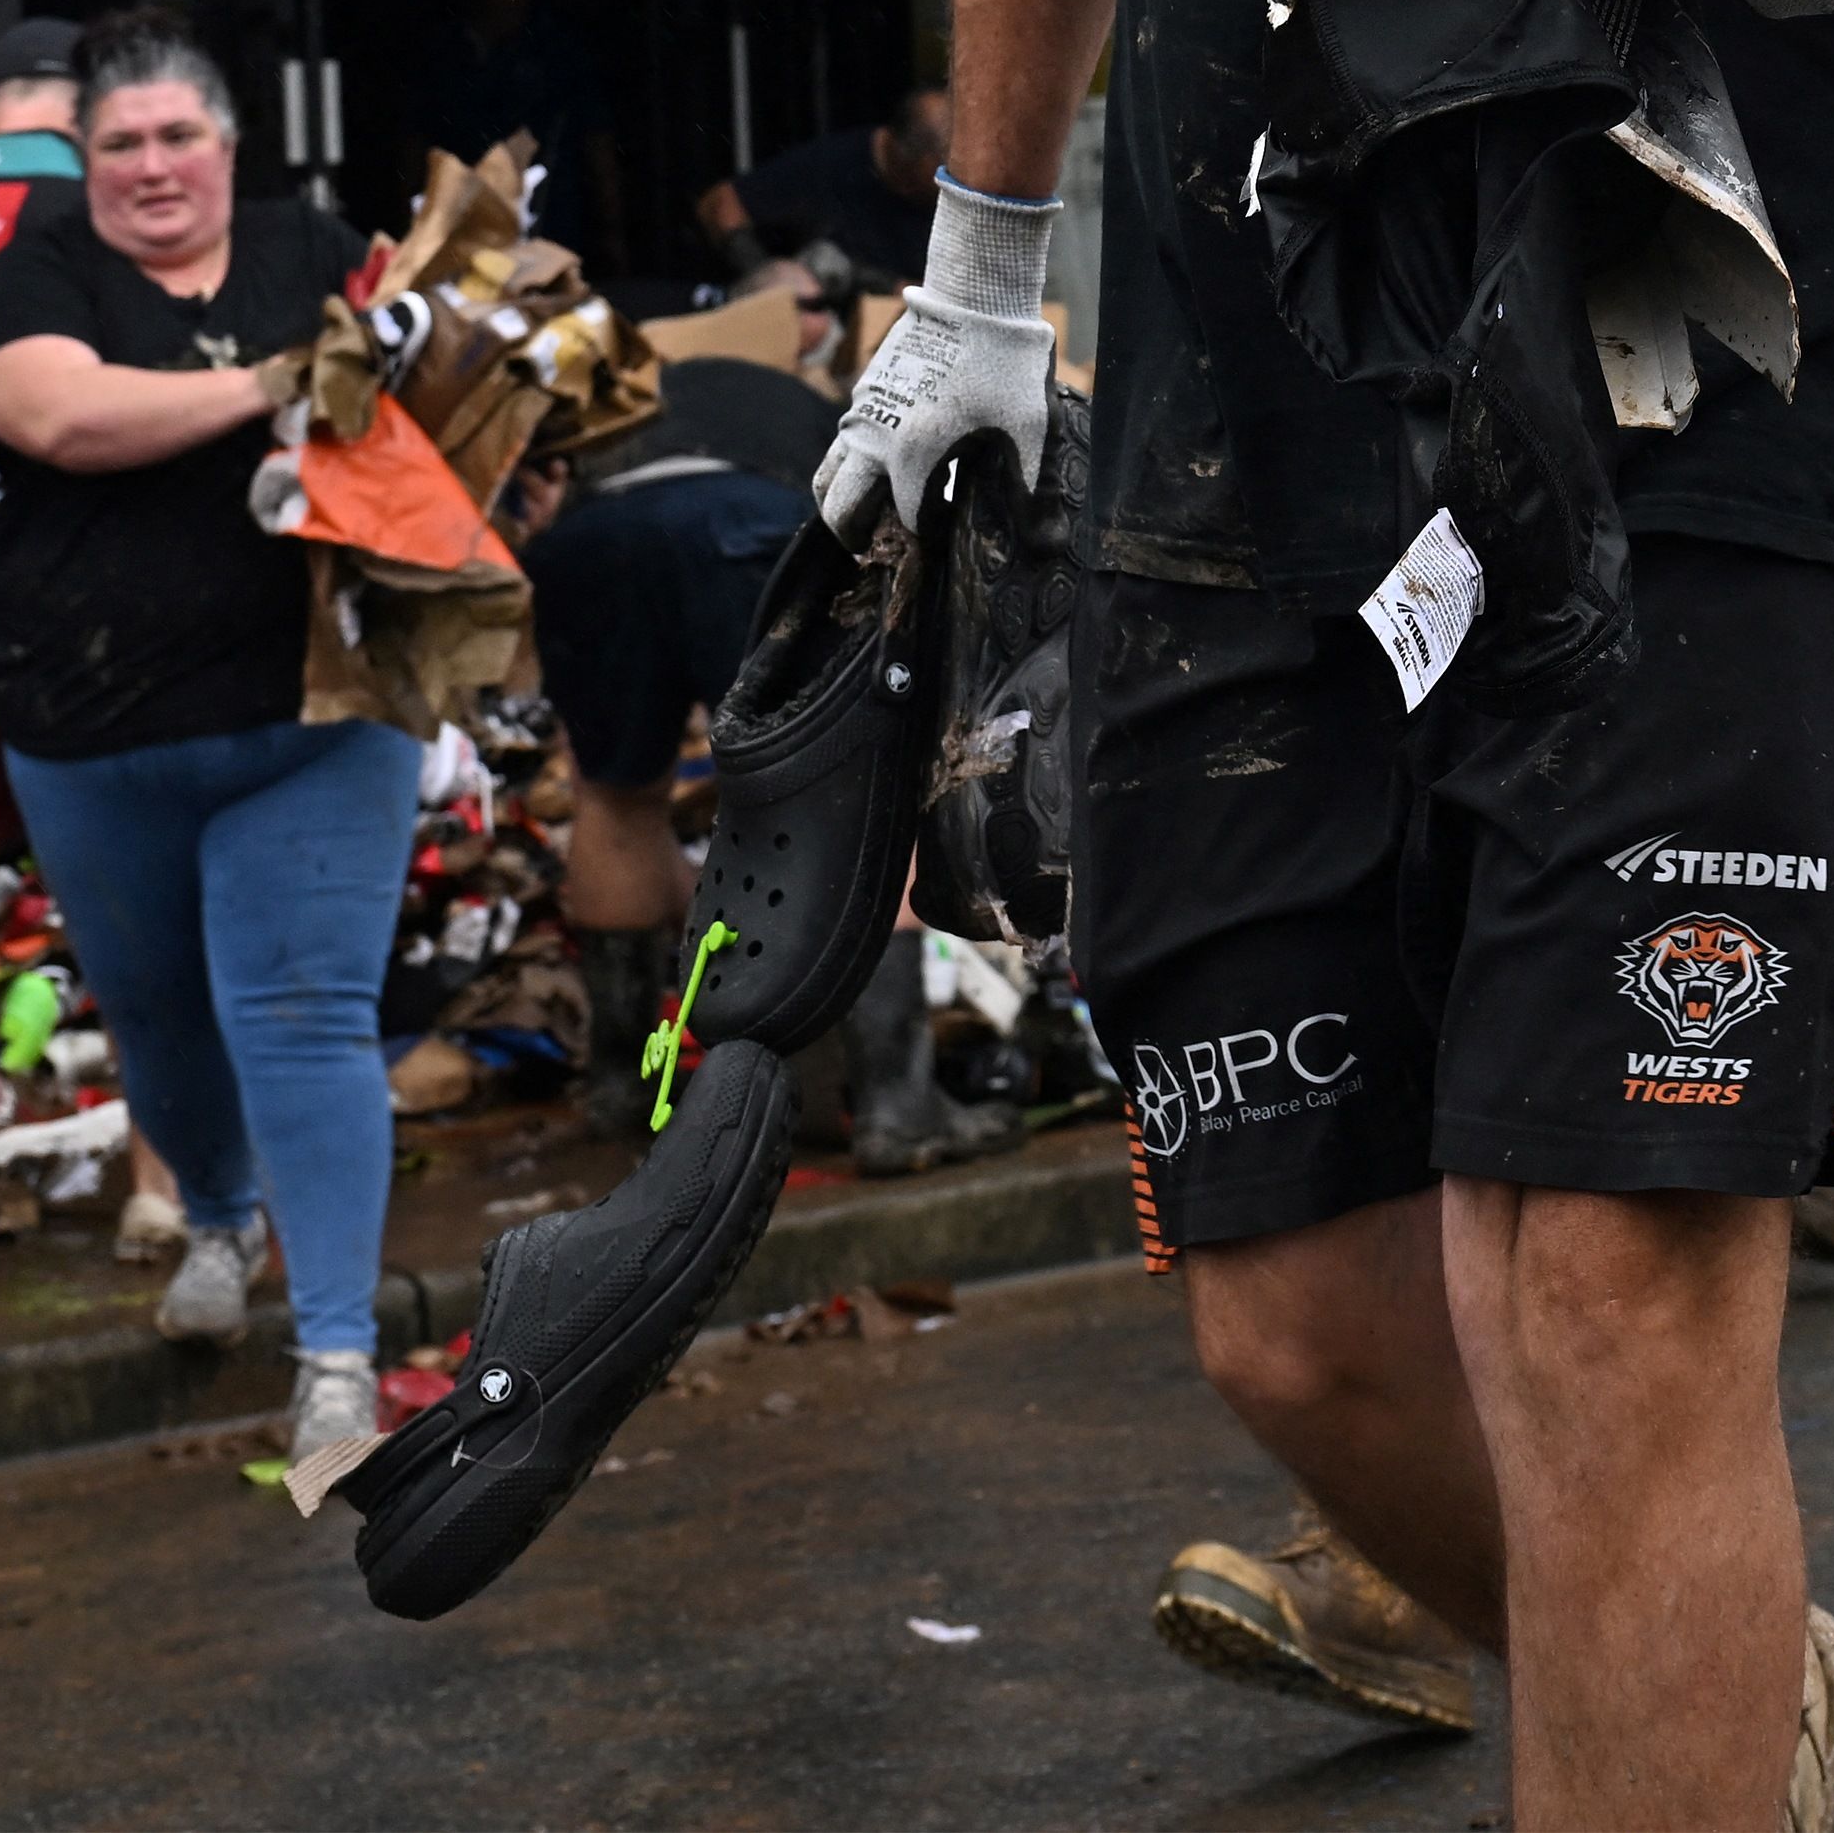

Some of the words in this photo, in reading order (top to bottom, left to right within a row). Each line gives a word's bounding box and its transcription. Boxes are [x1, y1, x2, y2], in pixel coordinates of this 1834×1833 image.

[1404, 613, 1431, 669] STEEDEN
[1653, 849, 1828, 891] STEEDEN
[1183, 1013, 1358, 1111] BPC
[1626, 1052, 1753, 1080] WESTS
[1622, 1078, 1744, 1106] TIGERS
[1239, 1097, 1301, 1124] Pearce
